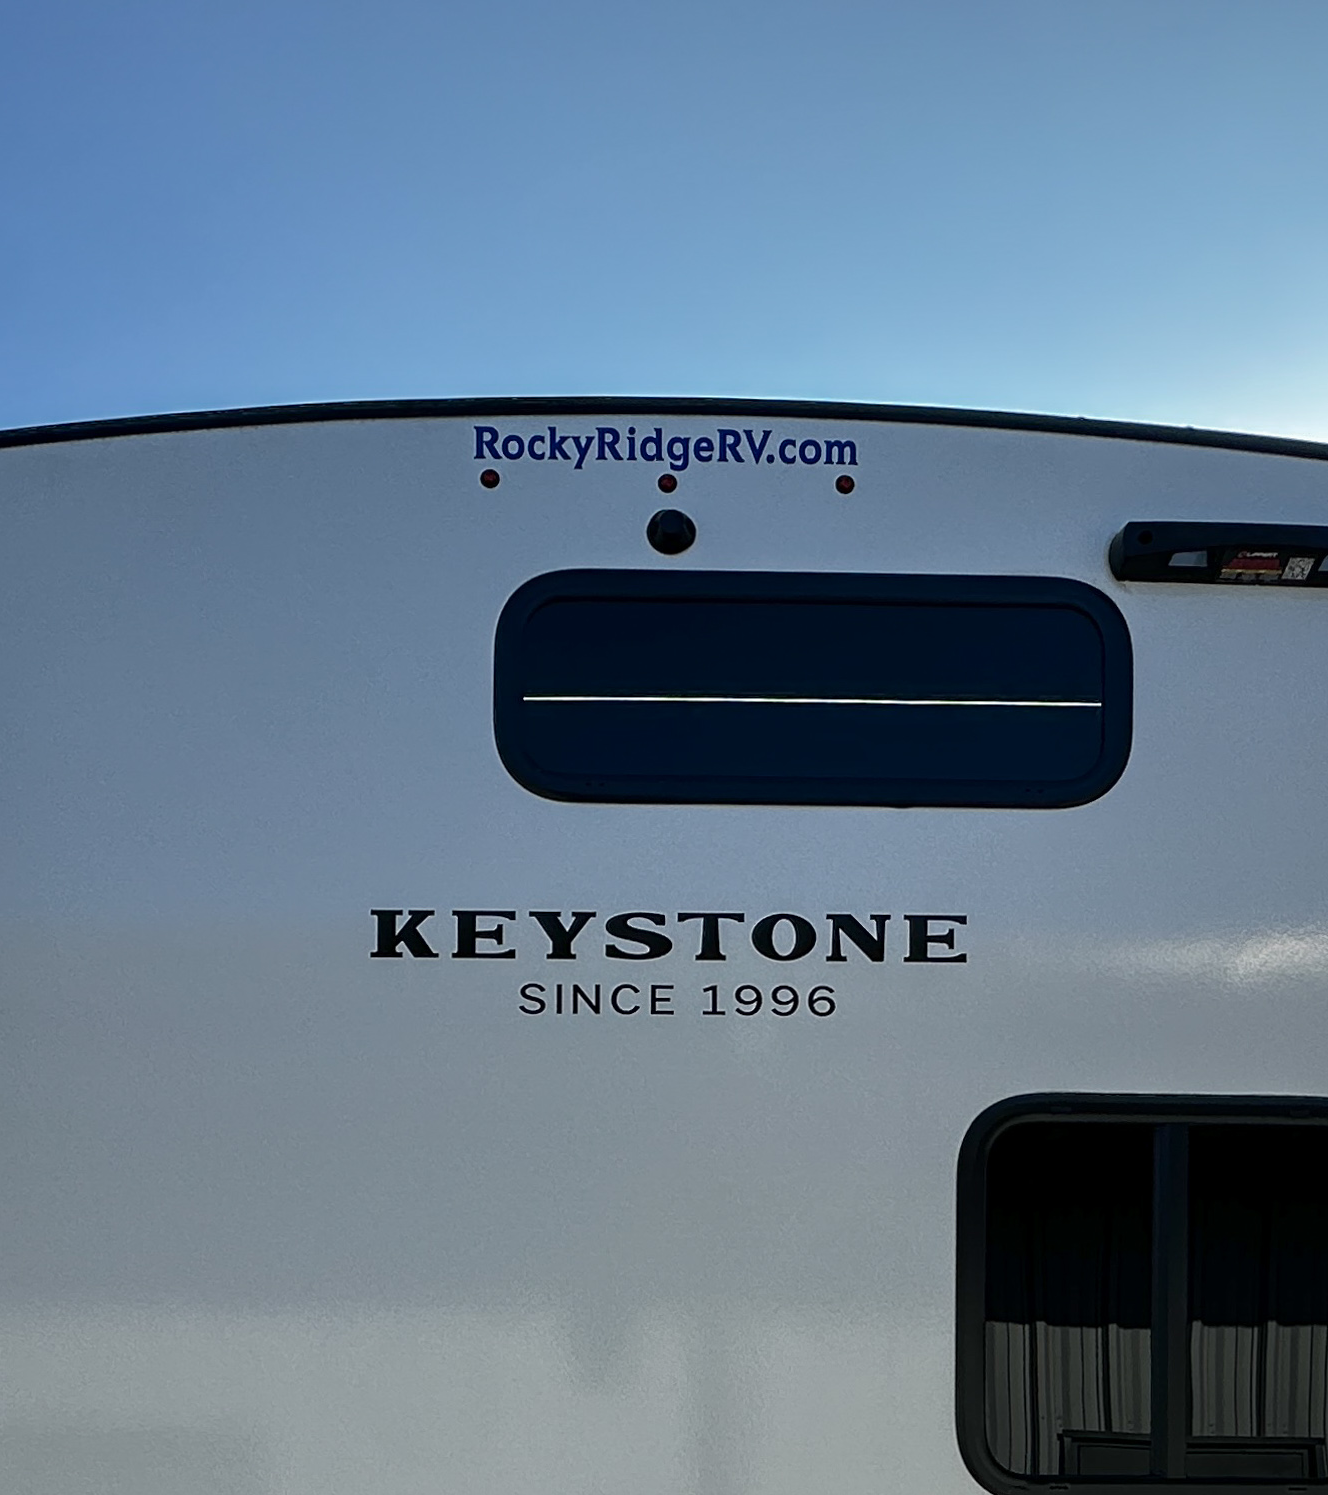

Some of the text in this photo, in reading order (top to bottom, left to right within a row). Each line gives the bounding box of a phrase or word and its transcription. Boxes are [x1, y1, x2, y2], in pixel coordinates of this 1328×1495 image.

[473, 425, 859, 472] RockyRidgeRV.com
[369, 909, 968, 964] KEYSTONE
[518, 983, 837, 1017] SINCE 1996
